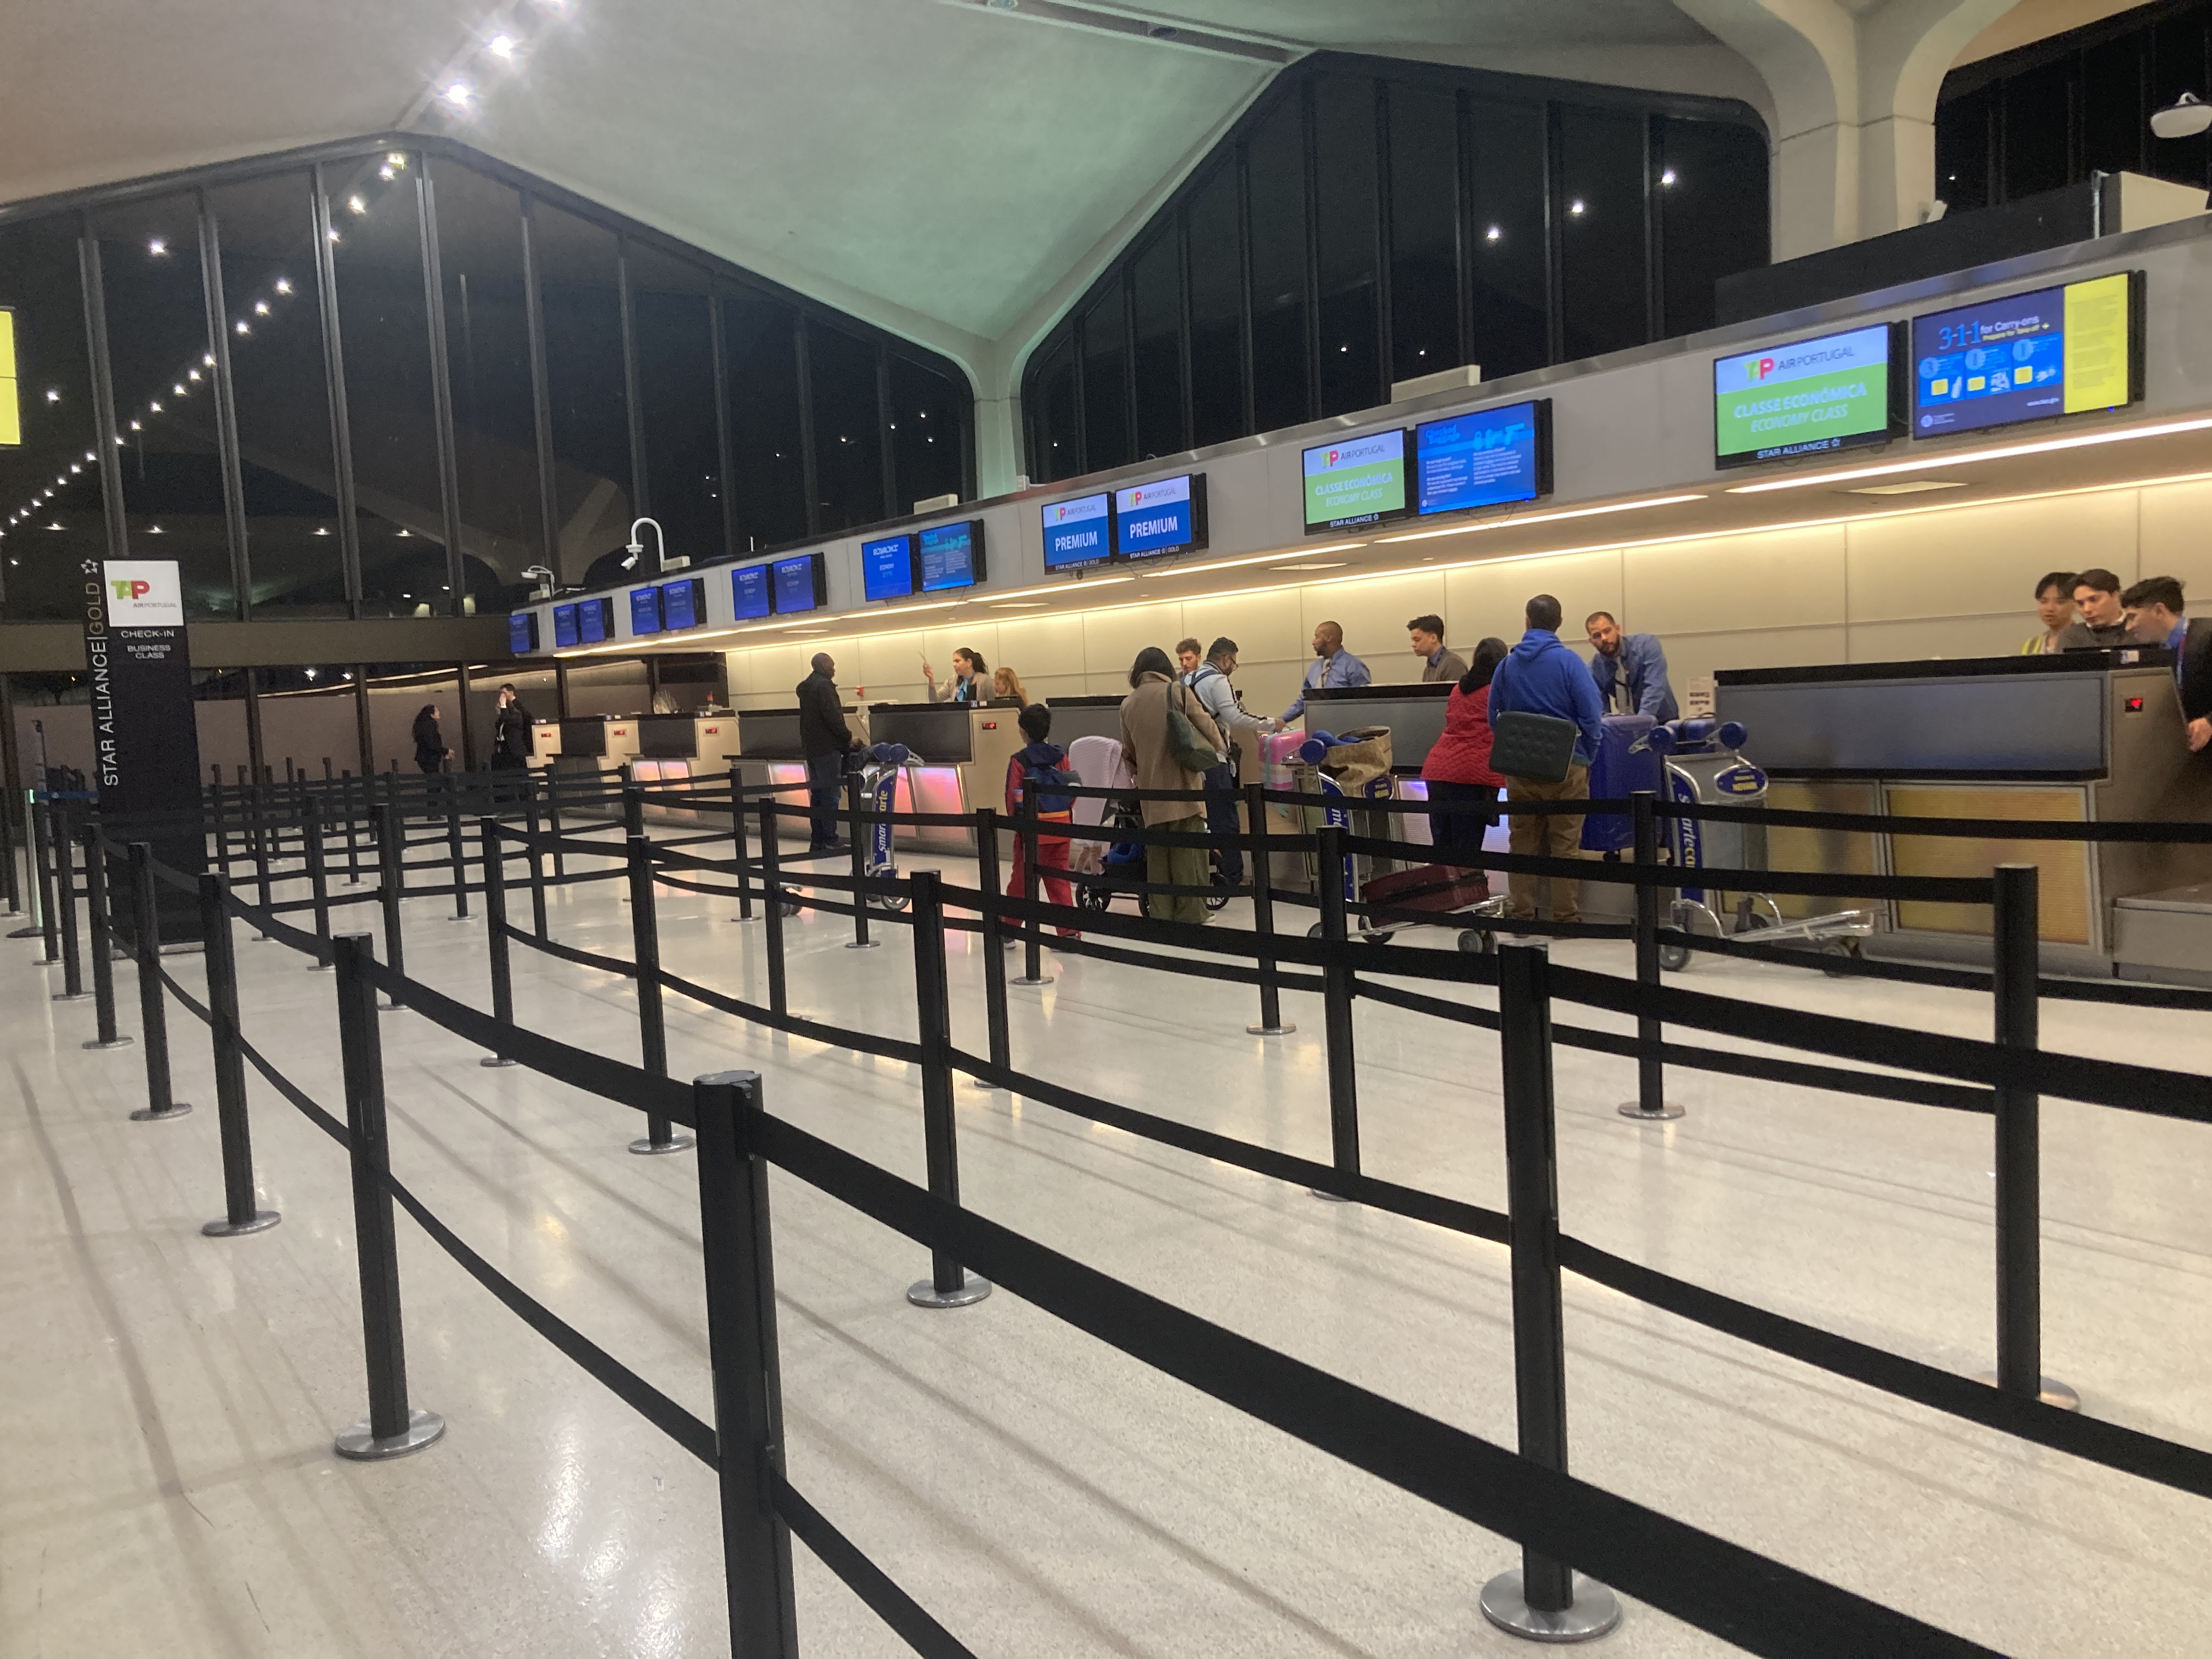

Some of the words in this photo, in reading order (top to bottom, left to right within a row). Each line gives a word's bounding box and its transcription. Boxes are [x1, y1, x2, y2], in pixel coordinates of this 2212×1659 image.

[1734, 399, 1781, 419] CLASSE
[1751, 410, 1809, 433] ECONOMY
[1811, 404, 1848, 422] CLASS
[1757, 448, 1781, 460] STAR
[1782, 439, 1829, 455] ALLIANCE
[1315, 482, 1343, 496] CLASSE
[1325, 492, 1360, 507] ECONOMY
[1361, 488, 1383, 501] CLASS
[1130, 516, 1178, 539] PREMIUM
[1329, 520, 1344, 528] STAR
[1345, 515, 1373, 526] ALLIANCE
[1055, 531, 1098, 552] PREMIUM
[1141, 548, 1161, 557] ALLIANCE
[1167, 545, 1180, 554] GOLD
[1065, 561, 1083, 569] ALLIANCE
[111, 580, 150, 600] TAP
[86, 582, 104, 635] GOLD
[121, 629, 175, 639] CHECK-IN
[127, 644, 171, 653] BUSINESS
[91, 640, 115, 734] ALLIANCE
[100, 738, 119, 786] STAR
